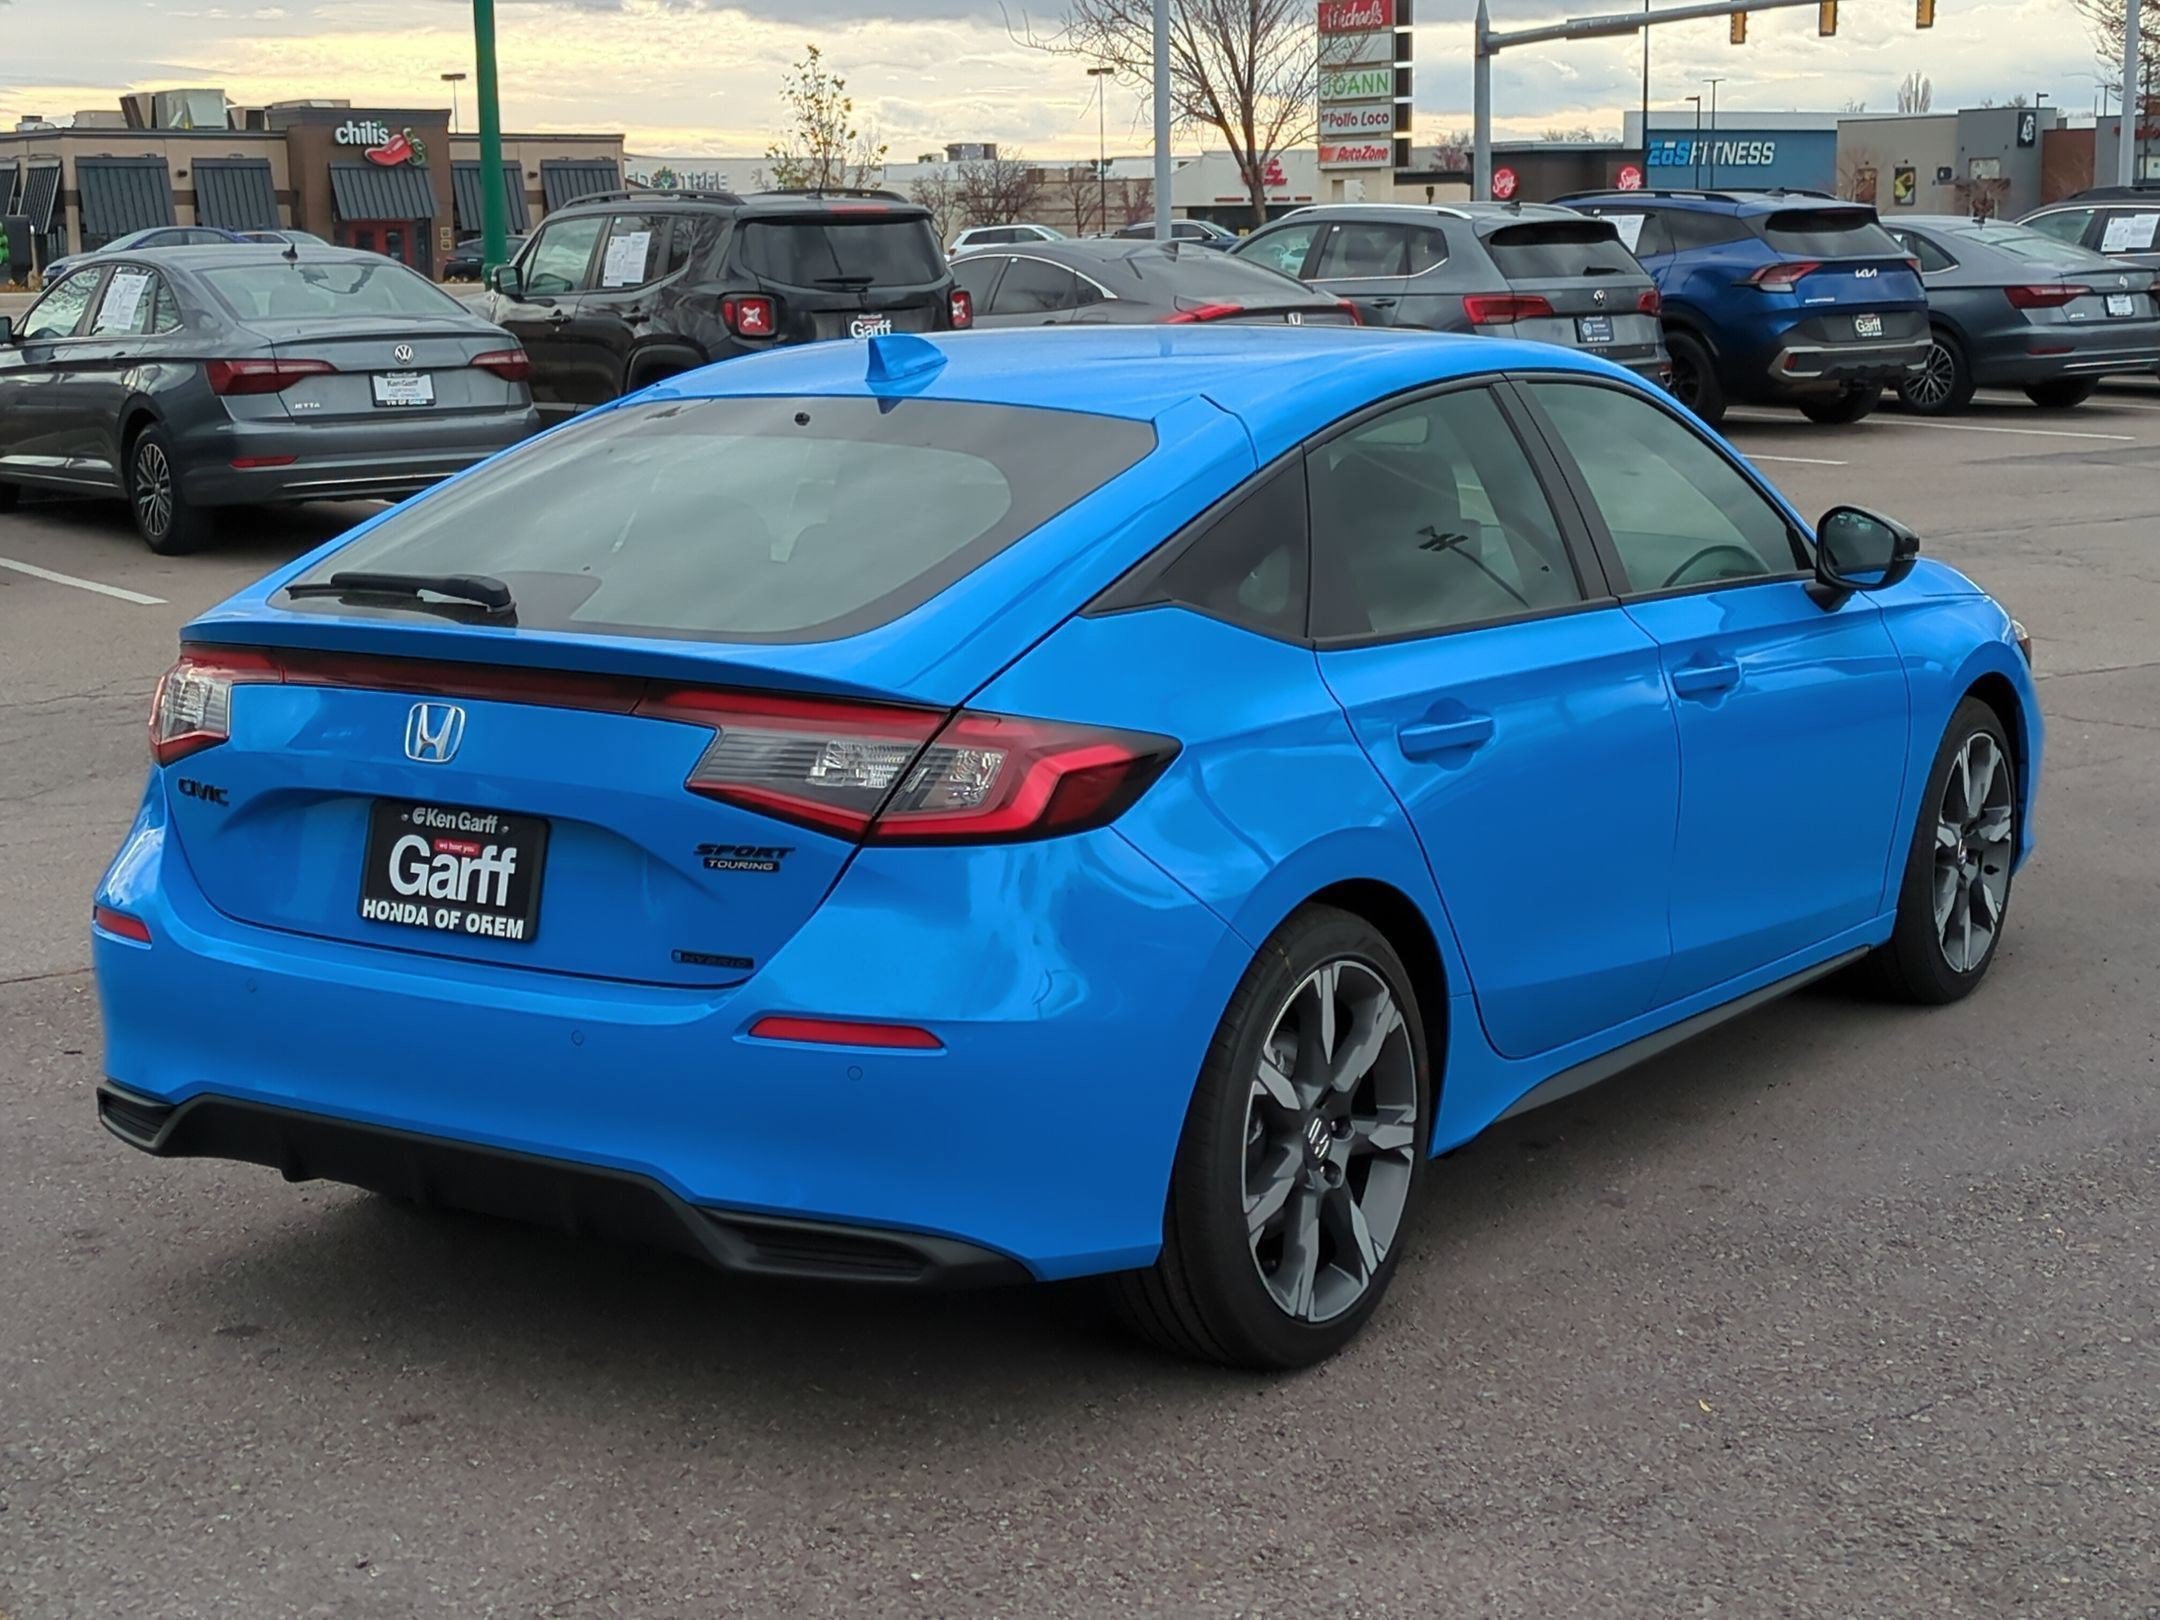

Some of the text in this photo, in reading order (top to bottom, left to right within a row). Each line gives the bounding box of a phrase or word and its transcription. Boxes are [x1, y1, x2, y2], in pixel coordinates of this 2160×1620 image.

[1322, 72, 1389, 96] JOANN
[1329, 112, 1358, 128] Pollo
[1360, 111, 1389, 127] Loco
[1336, 145, 1389, 162] AutoZone
[1688, 141, 1776, 165] FITNESS
[851, 319, 892, 339] Garff
[178, 778, 230, 807] CIVIC
[426, 807, 498, 834] Ken Garff
[693, 843, 796, 859] SPORT
[389, 834, 517, 906] Garff
[708, 859, 774, 871] TOURING
[362, 898, 524, 940] HONDA OF OREM
